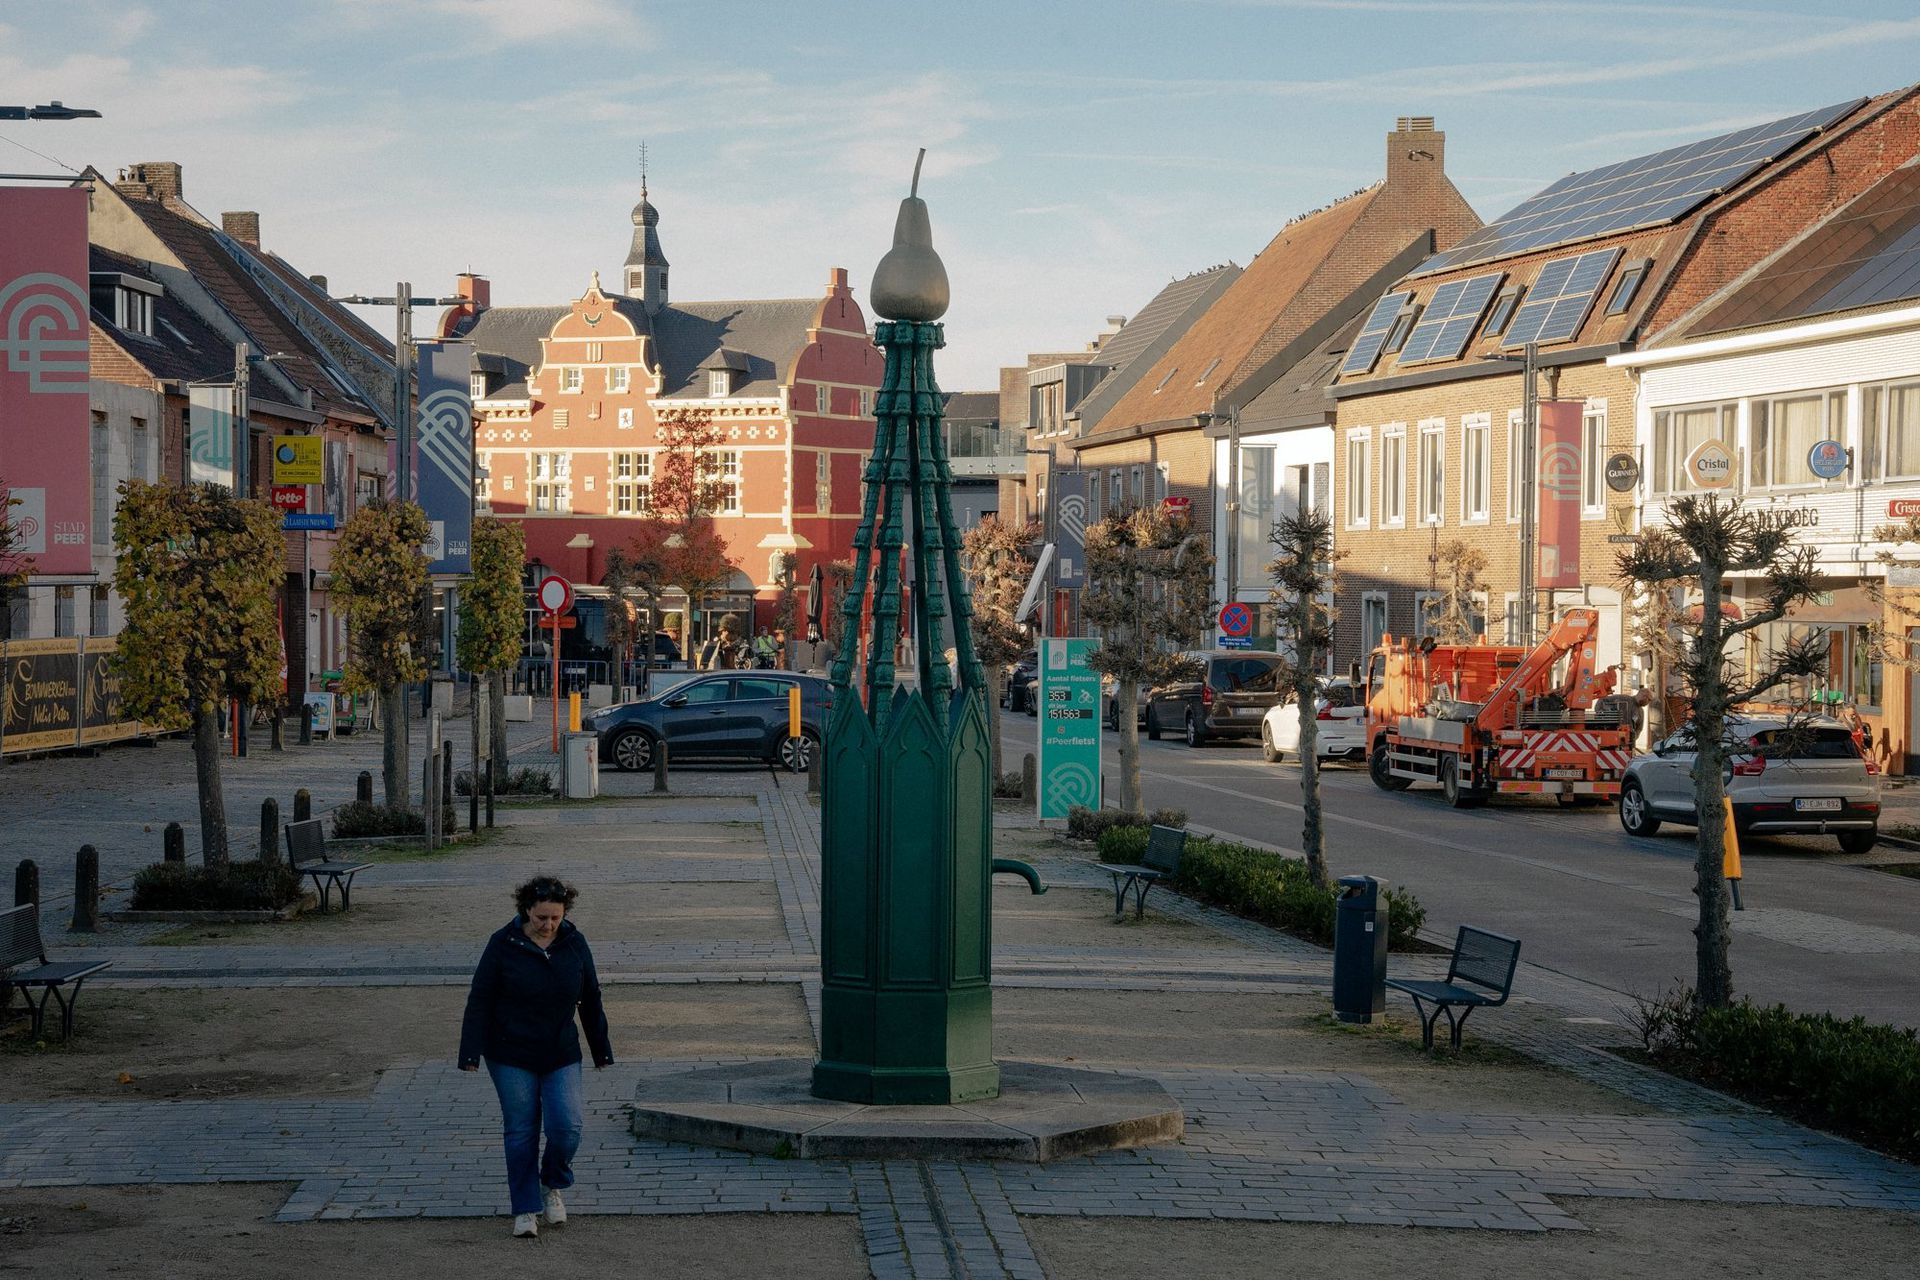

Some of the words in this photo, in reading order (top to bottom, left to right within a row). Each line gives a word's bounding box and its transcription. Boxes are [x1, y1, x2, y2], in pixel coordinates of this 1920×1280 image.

[1697, 458, 1729, 471] Cristal
[1608, 469, 1637, 478] GUINNESS
[54, 521, 85, 532] STAD
[54, 533, 85, 544] PEER
[1049, 691, 1066, 701] 353
[1046, 737, 1095, 745] #Peerfietst
